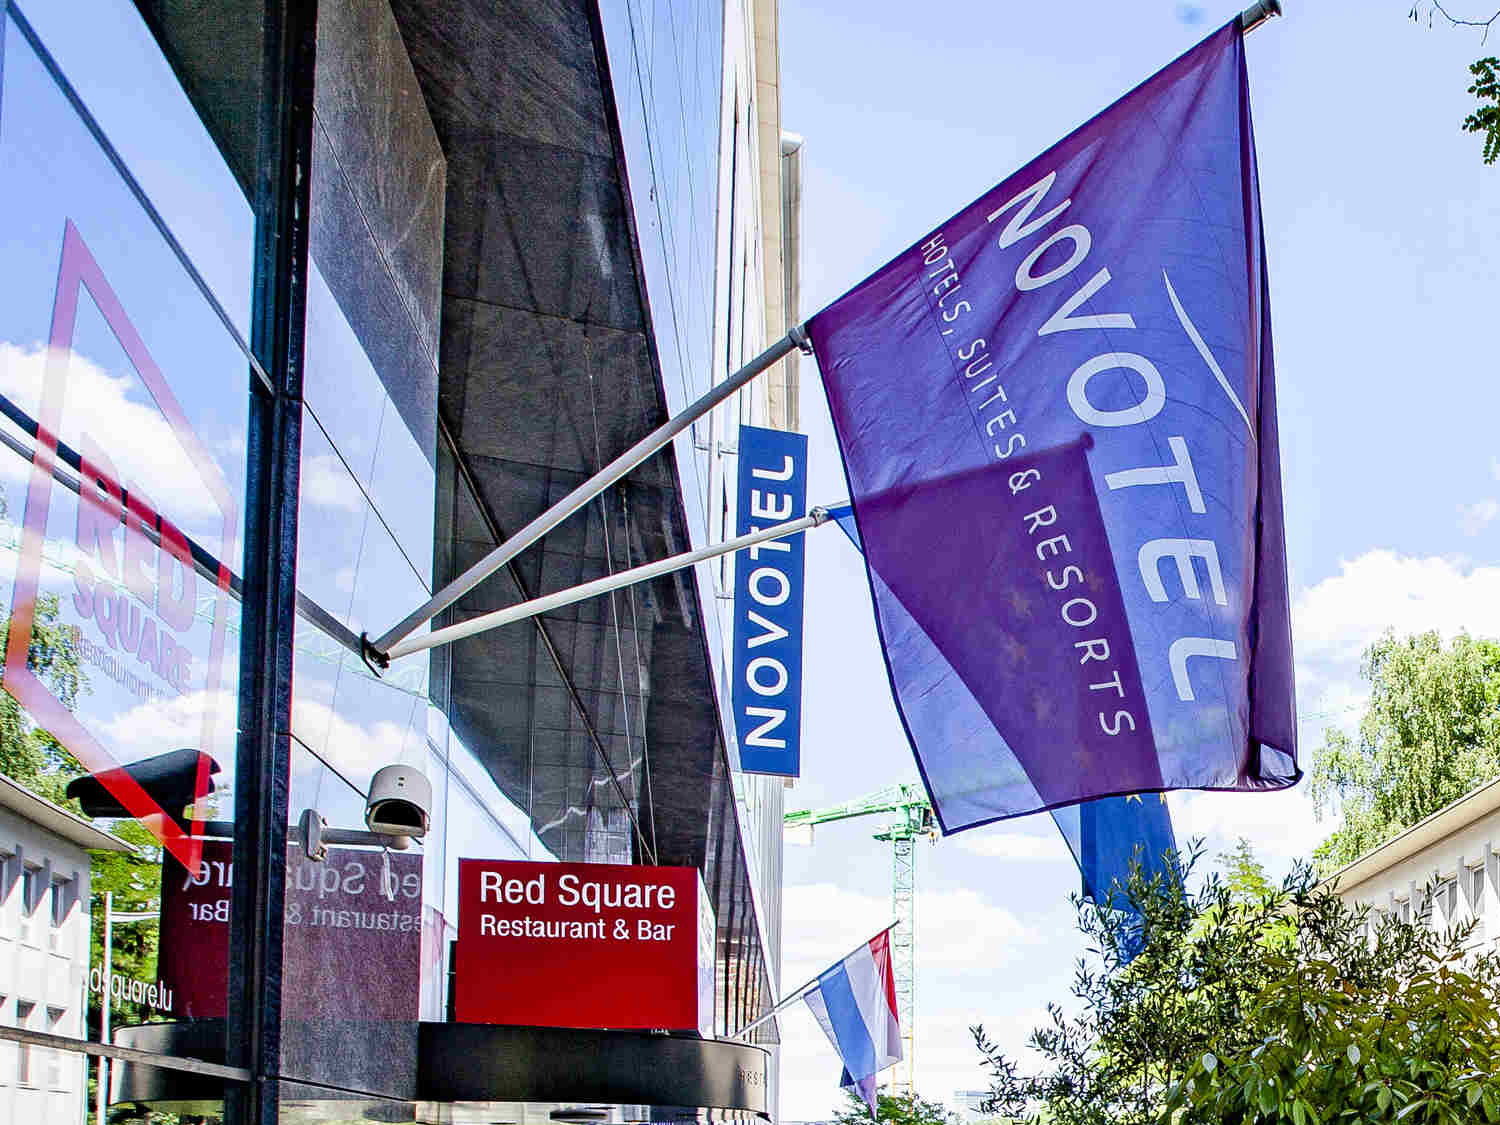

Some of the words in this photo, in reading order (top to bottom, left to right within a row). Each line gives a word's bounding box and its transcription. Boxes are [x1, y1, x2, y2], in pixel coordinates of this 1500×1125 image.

[920, 232, 972, 336] HOTELS,
[958, 338, 1026, 459] SUITES
[986, 170, 1237, 702] NOVOTEL
[1008, 469, 1041, 496] &
[745, 455, 794, 749] NOVOTEL
[1023, 504, 1136, 736] RESORTS
[480, 871, 545, 904] Red
[558, 874, 676, 913] Square
[480, 914, 606, 940] Restaurant
[612, 919, 630, 940] &
[637, 920, 676, 941] Bar
